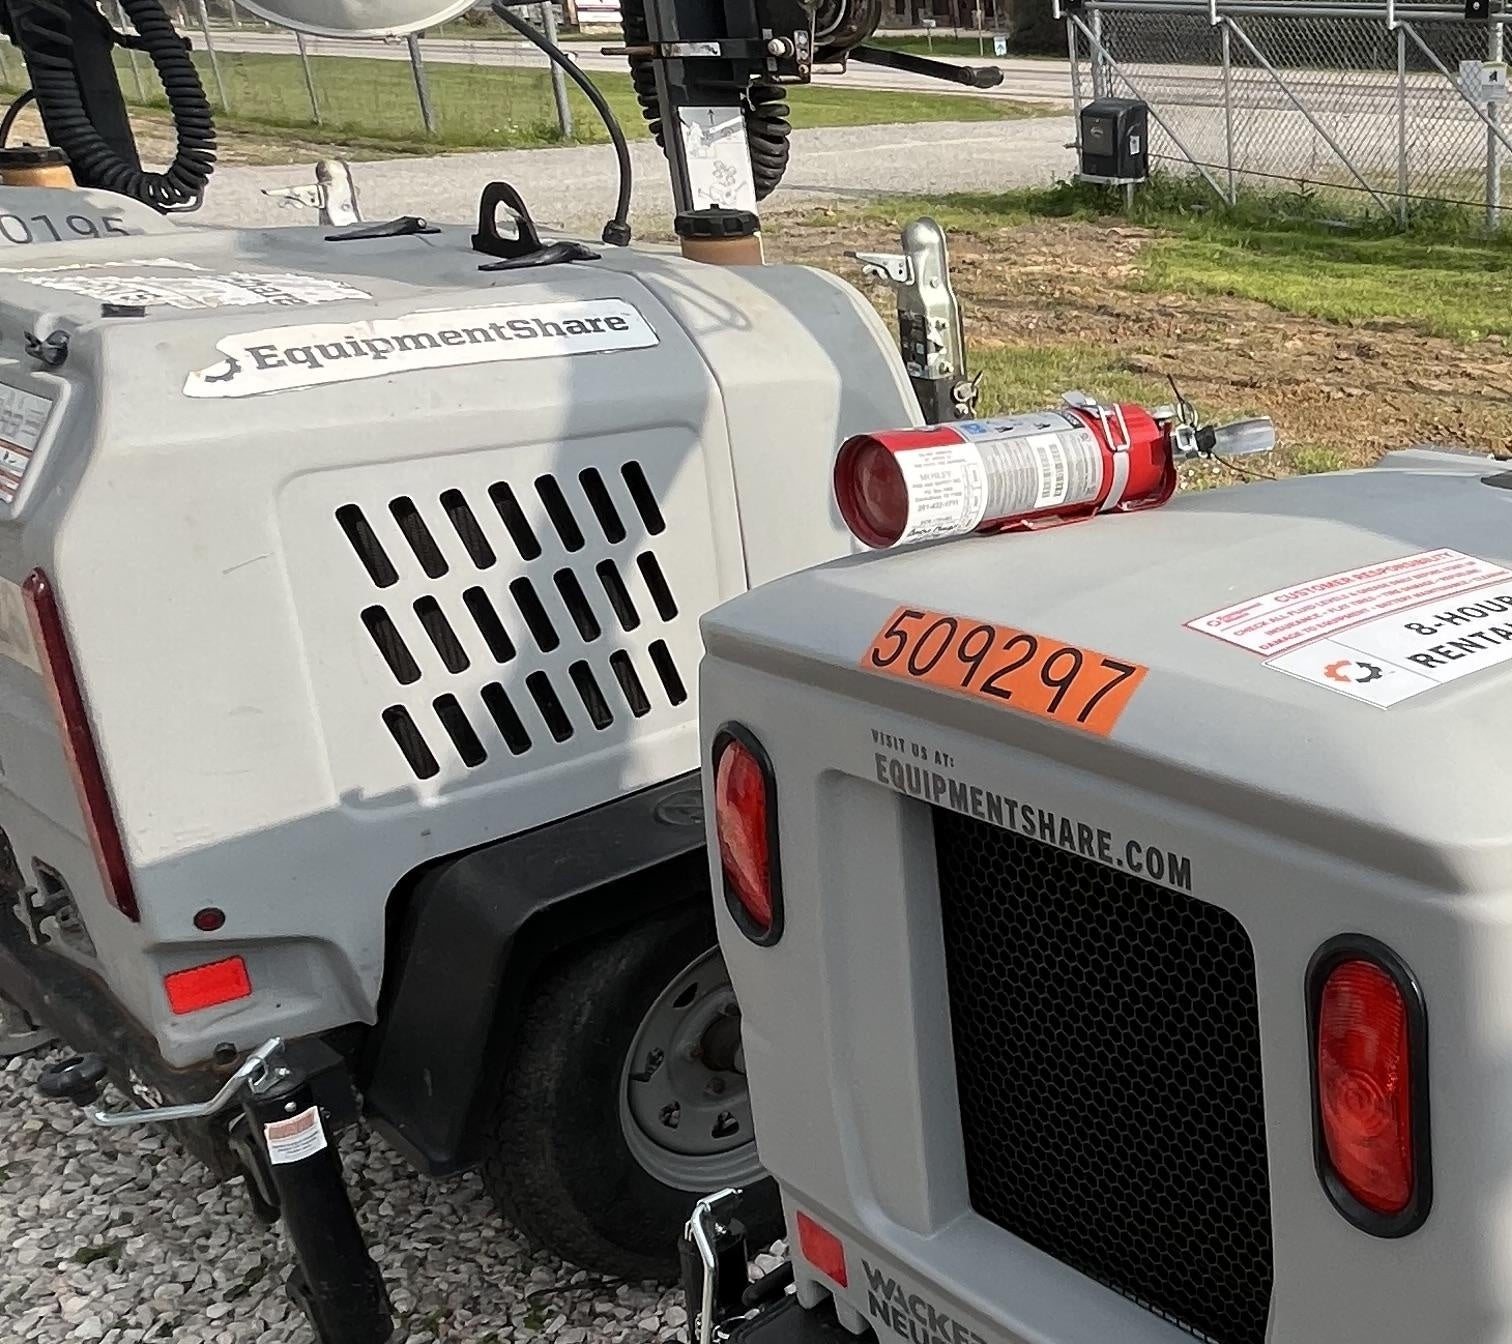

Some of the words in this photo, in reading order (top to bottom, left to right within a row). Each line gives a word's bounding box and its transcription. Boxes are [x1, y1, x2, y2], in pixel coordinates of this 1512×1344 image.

[243, 314, 629, 370] EquipmentShare
[1273, 576, 1355, 604] CUSTOMER
[871, 609, 1137, 723] 509297
[871, 728, 904, 753] VISIT
[911, 742, 927, 760] US
[934, 750, 954, 768] AT:
[874, 752, 1193, 891] EQUIPMENTSHARE.COM
